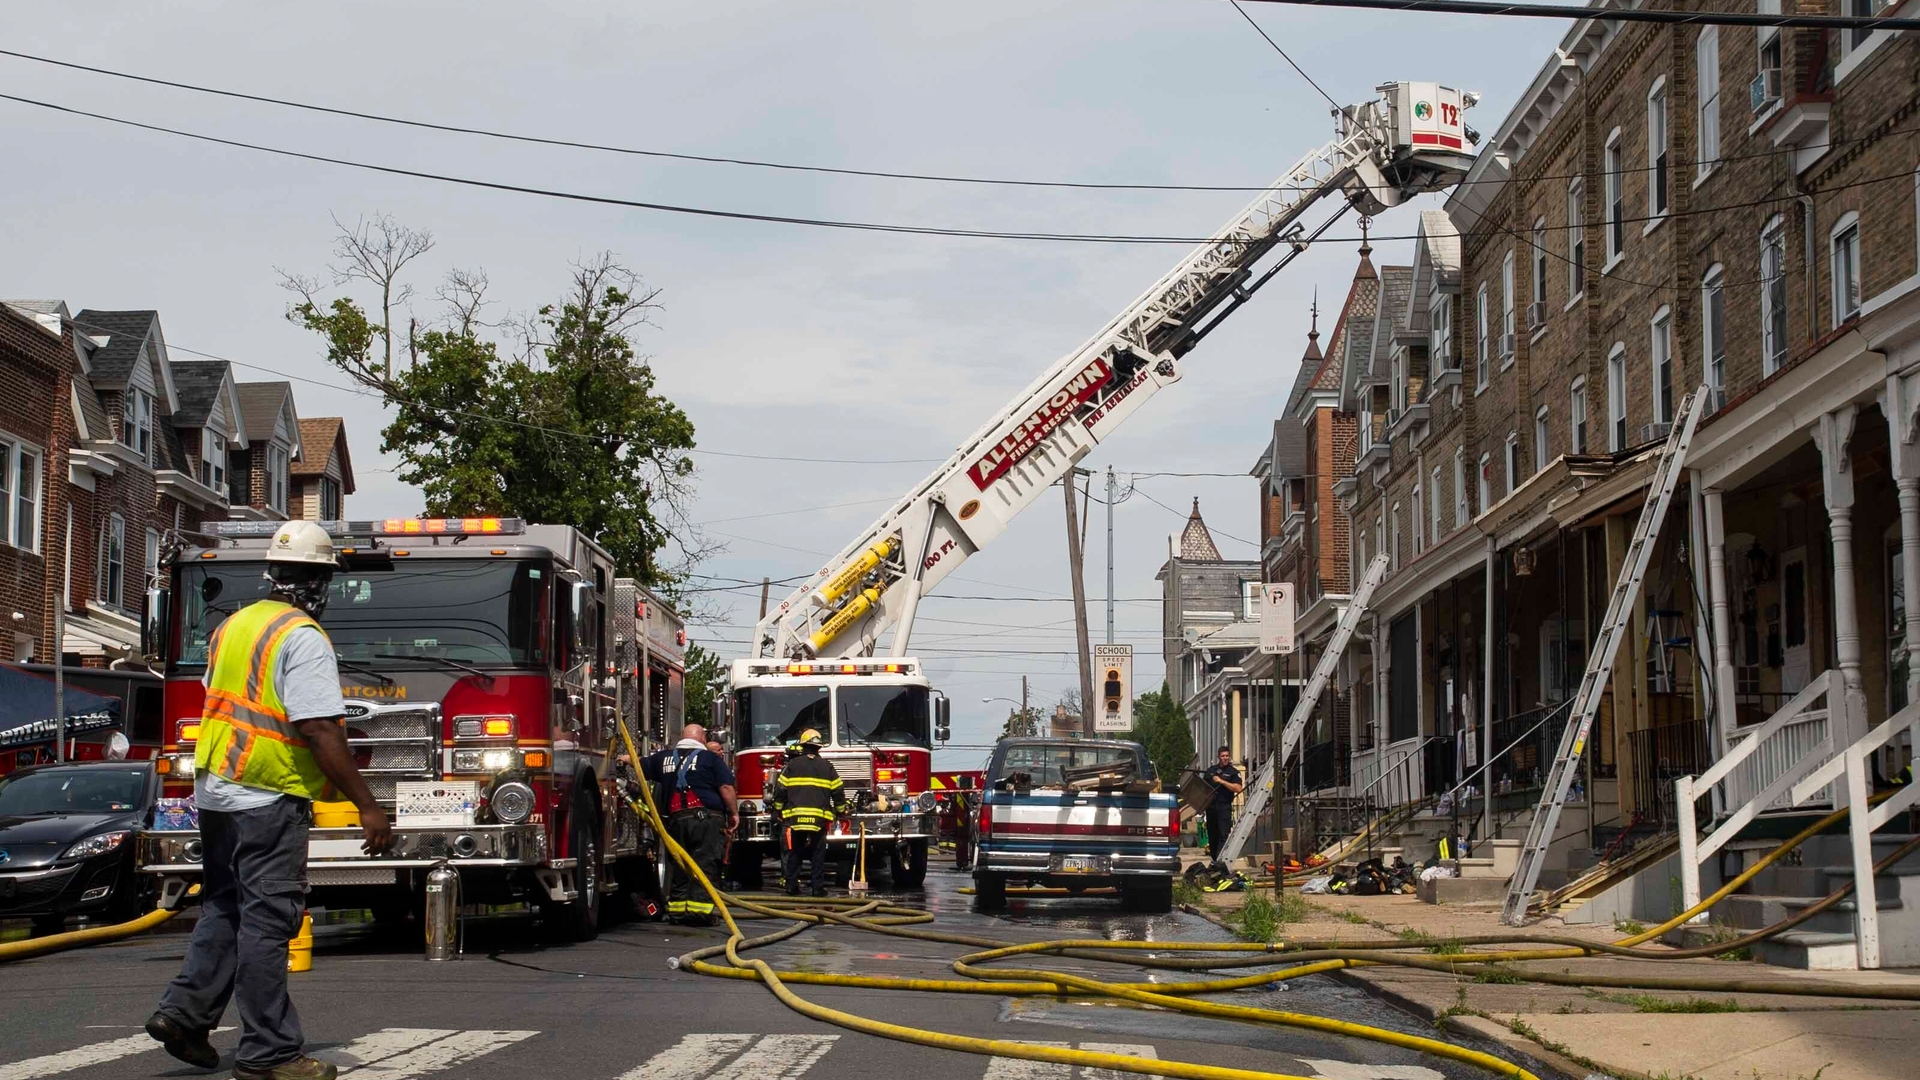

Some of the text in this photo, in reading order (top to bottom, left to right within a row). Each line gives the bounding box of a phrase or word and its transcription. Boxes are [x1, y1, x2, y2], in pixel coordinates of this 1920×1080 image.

[1441, 102, 1458, 127] T2
[978, 361, 1105, 482] ALLENTOWN
[1009, 397, 1080, 462] FIRE & RESCUE
[924, 539, 958, 571] 100 FT.
[819, 567, 829, 577] 50
[832, 560, 868, 591] BREATHING AIR
[800, 584, 810, 594] 45
[780, 601, 790, 611] 40
[823, 605, 859, 636] BREATHING AIR
[1097, 647, 1130, 655] SCHOOL
[797, 816, 816, 824] AGOSTO
[1128, 827, 1163, 835] FORD
